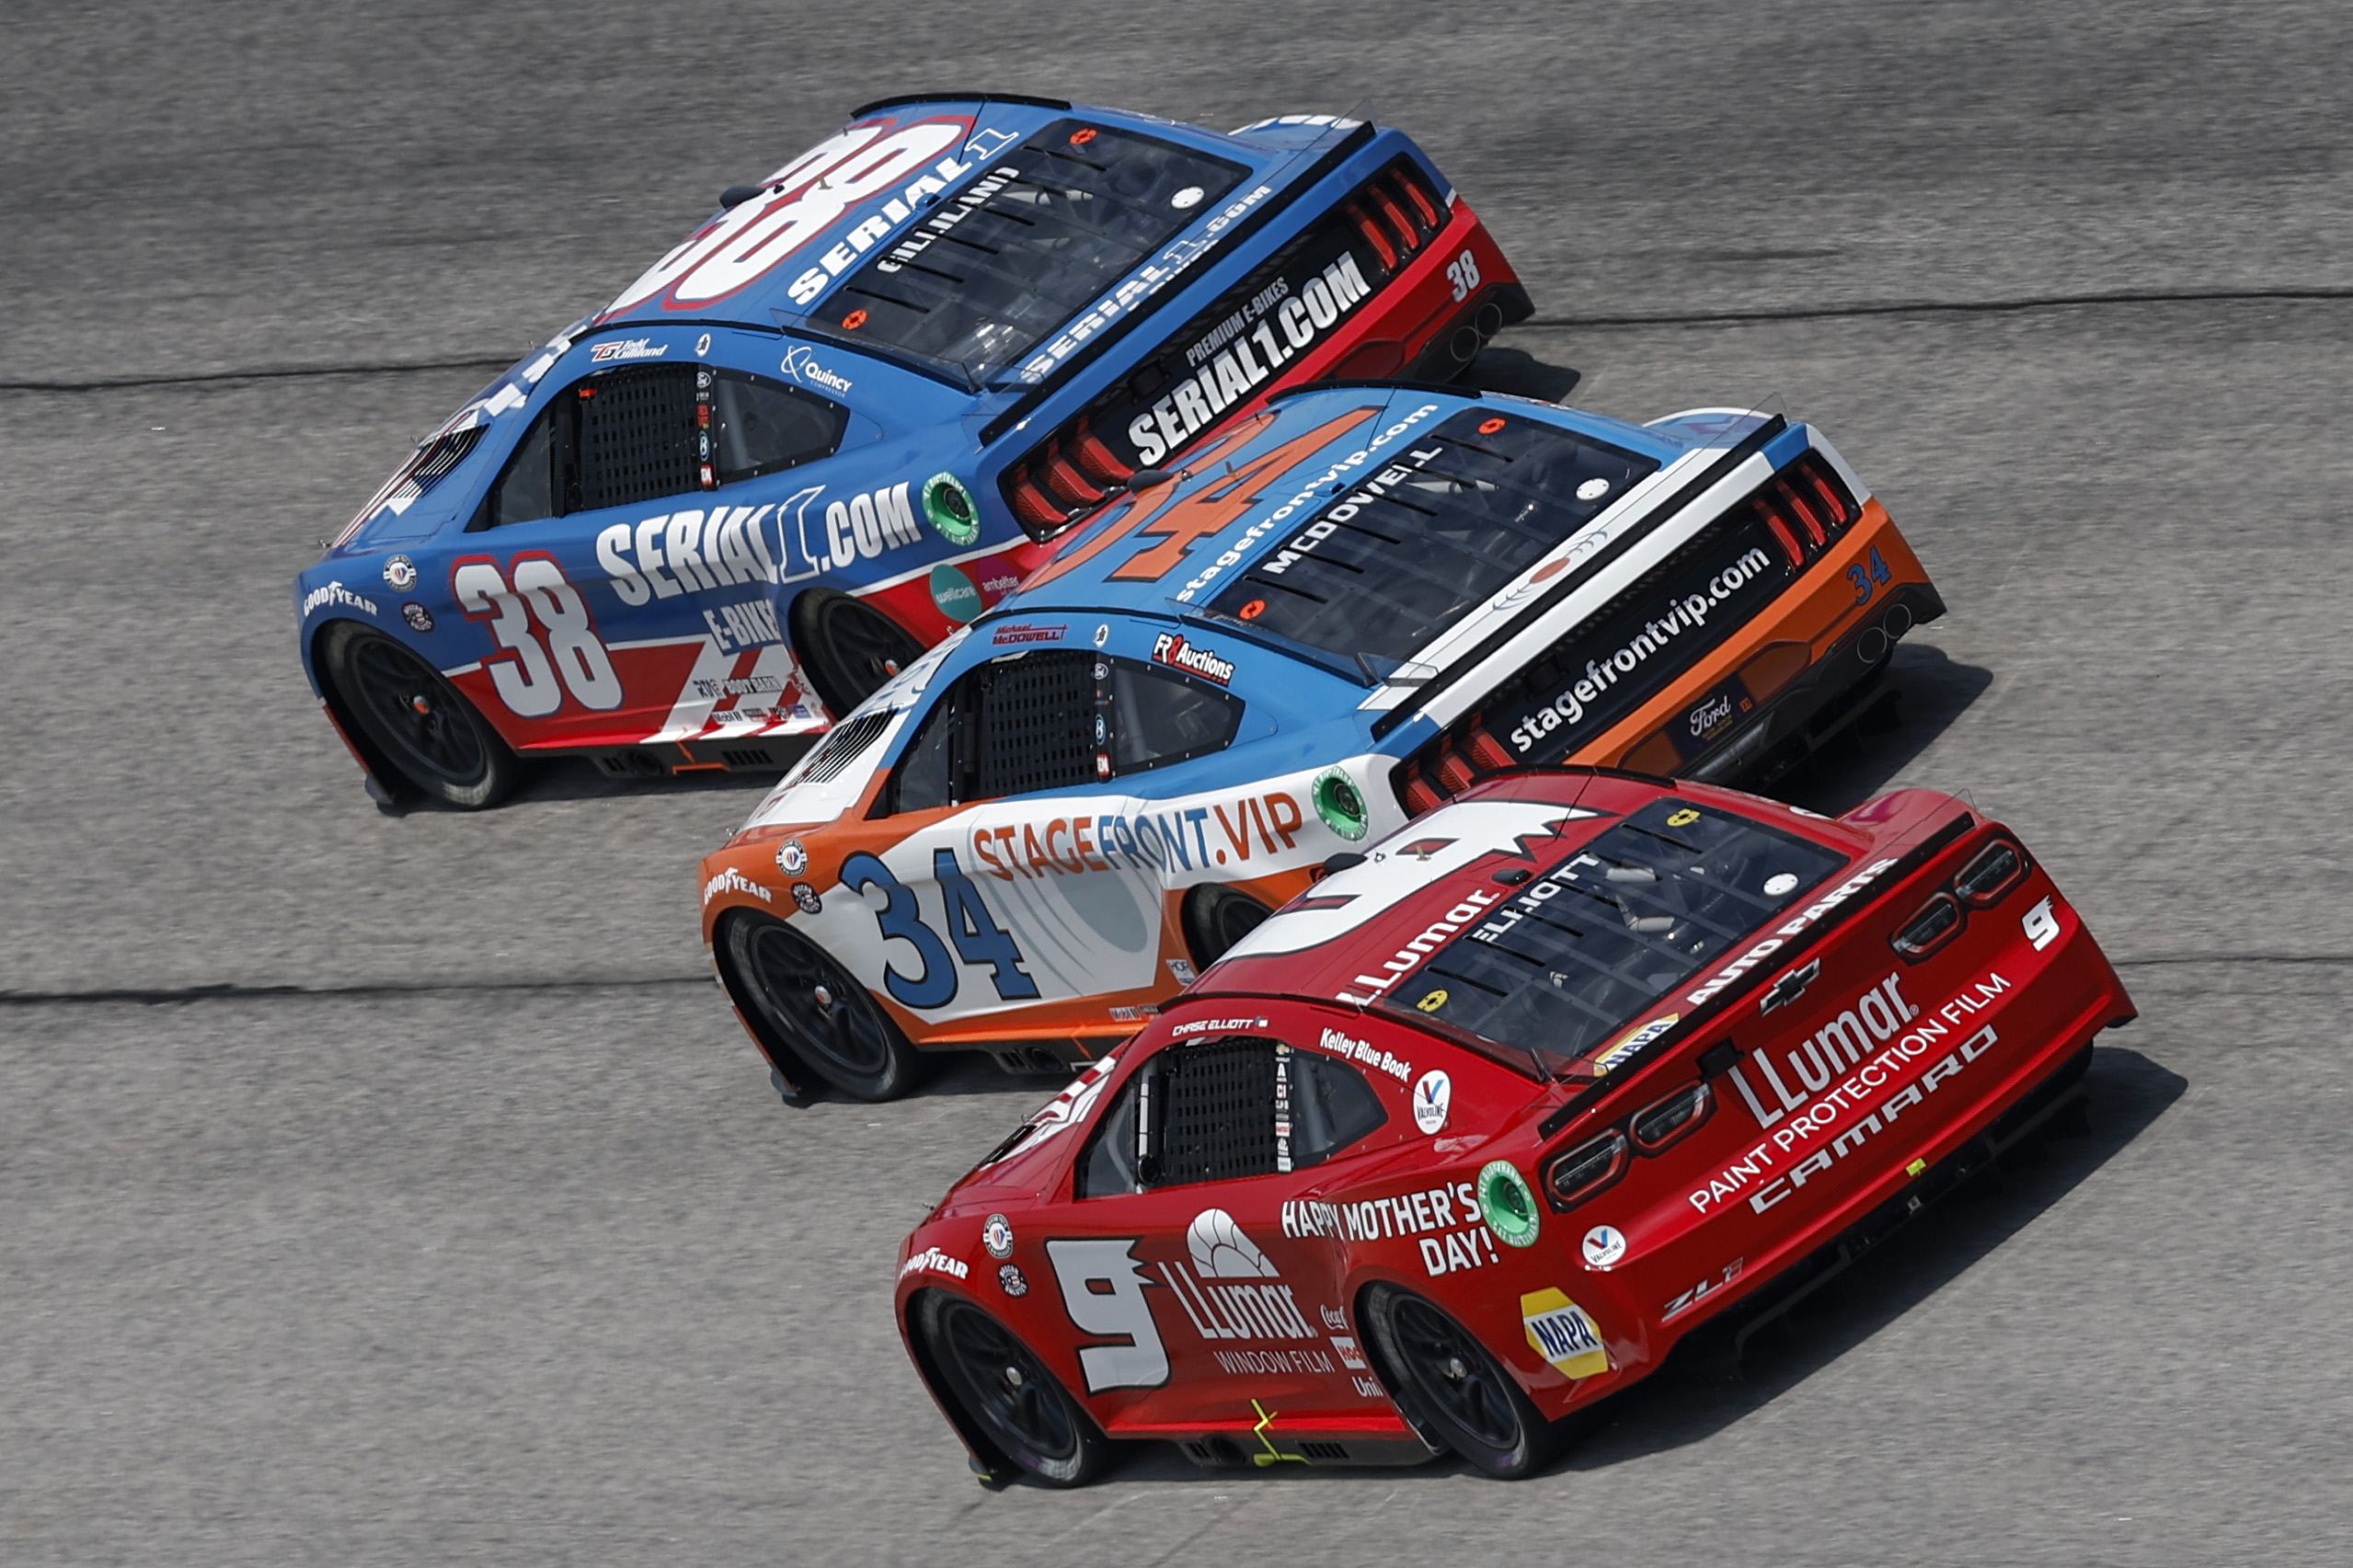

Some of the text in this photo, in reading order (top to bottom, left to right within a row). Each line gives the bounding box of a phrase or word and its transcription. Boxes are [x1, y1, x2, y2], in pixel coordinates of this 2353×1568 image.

[1446, 248, 1481, 303] 38
[1186, 276, 1289, 367] PREMIUM E-BIKES
[805, 362, 853, 392] Quincy
[1127, 251, 1372, 467] SERIAL1.COM
[1176, 405, 1438, 602] stagefrontvip.com
[304, 581, 378, 617] GOODYEAR
[935, 586, 976, 604] wellcare
[981, 576, 1019, 592] ambetter
[1846, 545, 1892, 606] 34
[452, 552, 624, 718] 38
[1509, 546, 1771, 752] stagefrontvip.com
[1690, 695, 1731, 736] Ford
[704, 866, 773, 904] GOODYEAR
[1472, 854, 1601, 943] ELLIOTT
[839, 847, 1041, 1009] 34
[1336, 888, 1495, 1008] LLumar
[2022, 894, 2060, 952] 9
[1605, 858, 1900, 1068] NAPA AUTO PARTS
[1172, 1018, 1254, 1036] CHASE ELLIOTT
[1320, 1027, 1412, 1082] Kelley Blue Book
[1689, 972, 2012, 1214] PAINT PROTECTION FILM
[1749, 1024, 1999, 1215] CAMARO
[1281, 1182, 1482, 1242] HAPPY MOTHER'S
[1418, 1226, 1500, 1277] DAY!
[1046, 1238, 1170, 1395] 9
[1157, 1261, 1314, 1339] LLumar
[1213, 1350, 1336, 1374] WINDOW FILM
[1532, 1310, 1599, 1358] NAPA
